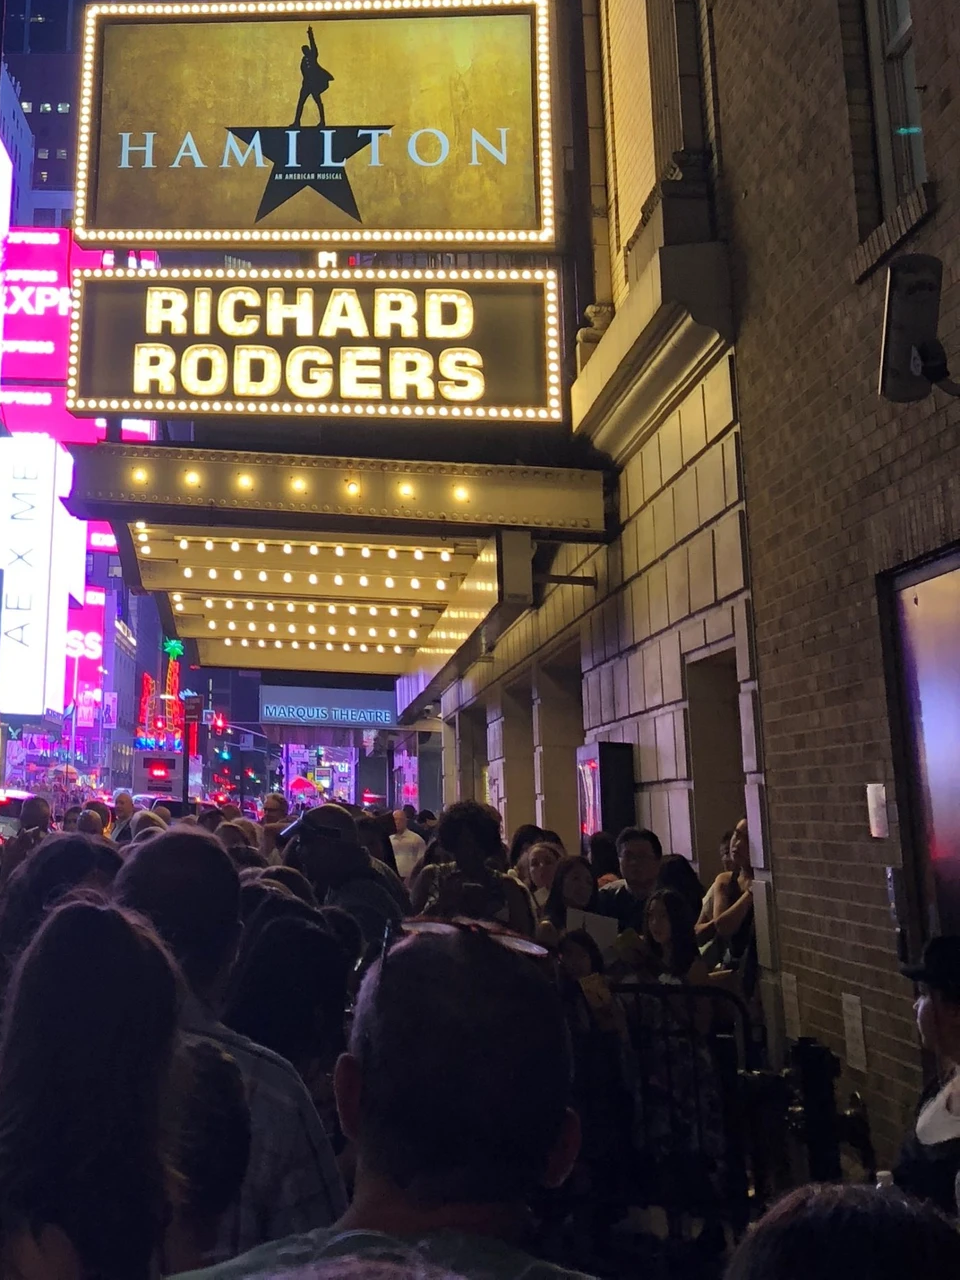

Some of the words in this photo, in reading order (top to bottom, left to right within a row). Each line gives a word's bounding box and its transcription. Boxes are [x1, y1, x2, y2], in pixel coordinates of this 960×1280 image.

[117, 127, 511, 170] HAMILTON
[145, 285, 475, 339] RICHARD
[132, 342, 485, 402] RODGERS
[7, 548, 34, 568] X
[264, 704, 329, 722] MARQUIS
[332, 705, 391, 723] THEATRE
